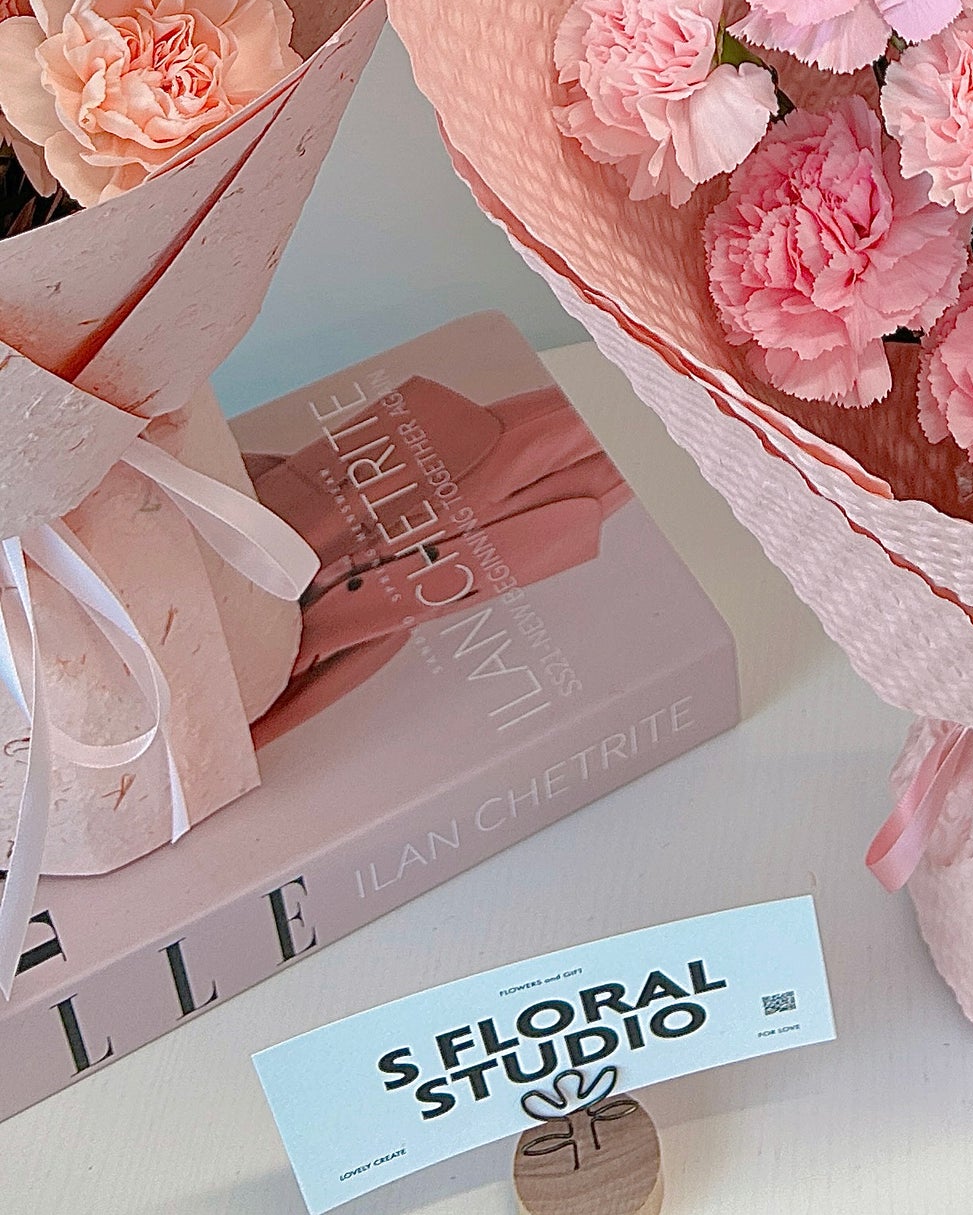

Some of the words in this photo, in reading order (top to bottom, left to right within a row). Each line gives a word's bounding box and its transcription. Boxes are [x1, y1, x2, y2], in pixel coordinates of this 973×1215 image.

[308, 381, 475, 607] CHETRITE
[398, 419, 463, 511] TOGETHER
[439, 607, 552, 731] ILAN
[355, 818, 460, 899] ILAN
[474, 695, 697, 832] CHETRITE
[49, 875, 318, 1078] LLE
[377, 1046, 420, 1092] S
[434, 958, 728, 1071] FLORAL
[499, 978, 543, 997] FLOWERS
[414, 1001, 707, 1121] STUDIO
[339, 1162, 372, 1182] LOVELY
[372, 1148, 407, 1166] CREATE
